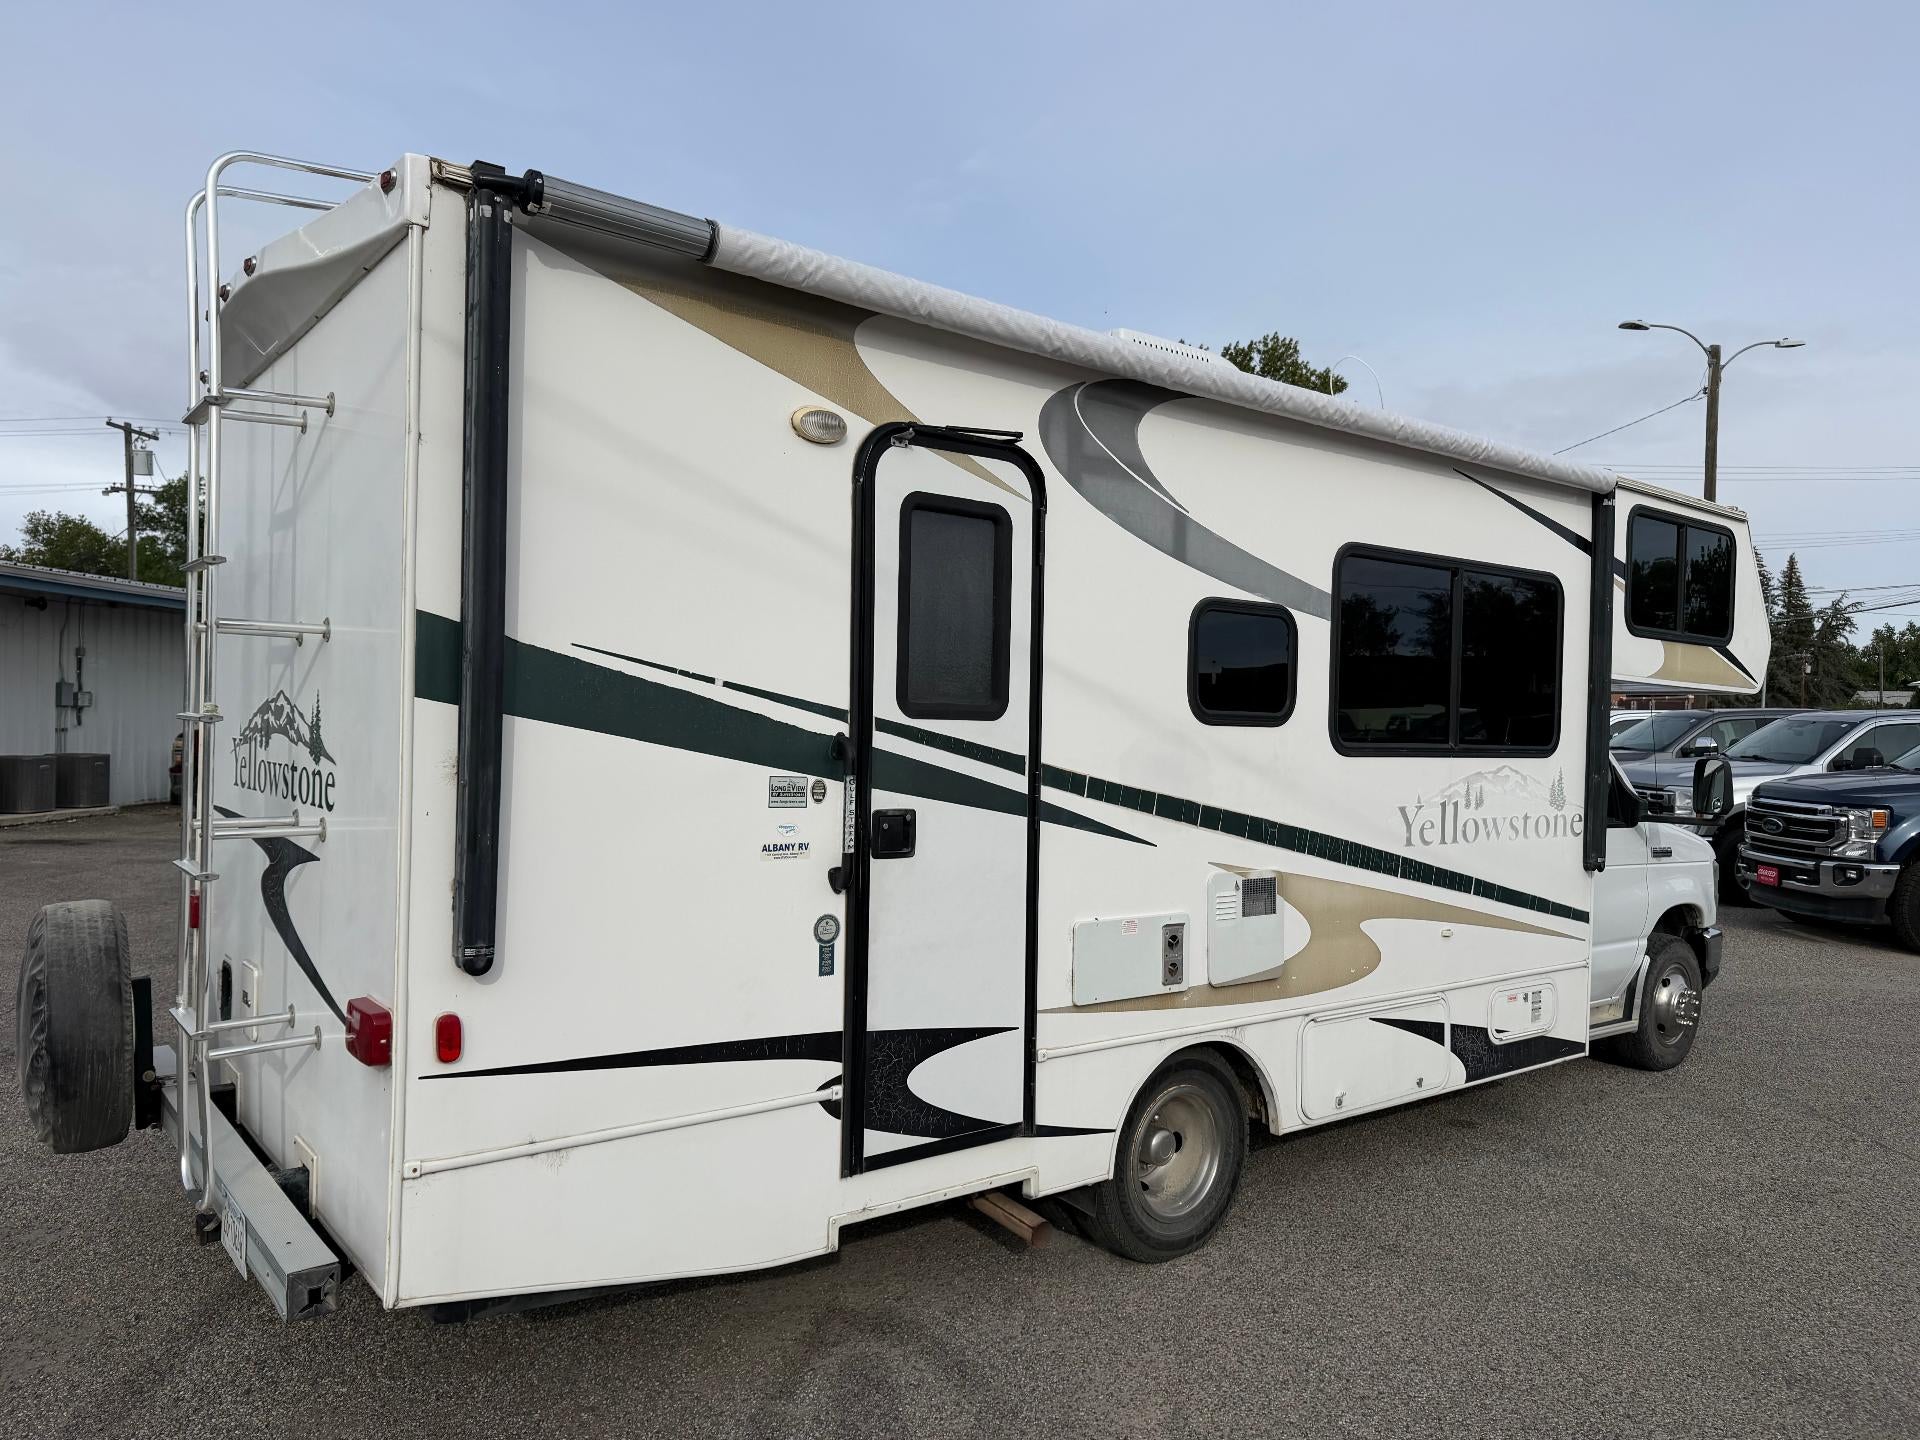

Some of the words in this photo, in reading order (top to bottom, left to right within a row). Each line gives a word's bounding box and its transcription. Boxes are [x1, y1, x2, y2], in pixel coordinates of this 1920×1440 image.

[232, 736, 335, 812] Yellowstone
[1398, 800, 1583, 847] Yellowstone
[762, 843, 796, 852] ALBANY
[798, 843, 809, 851] RV
